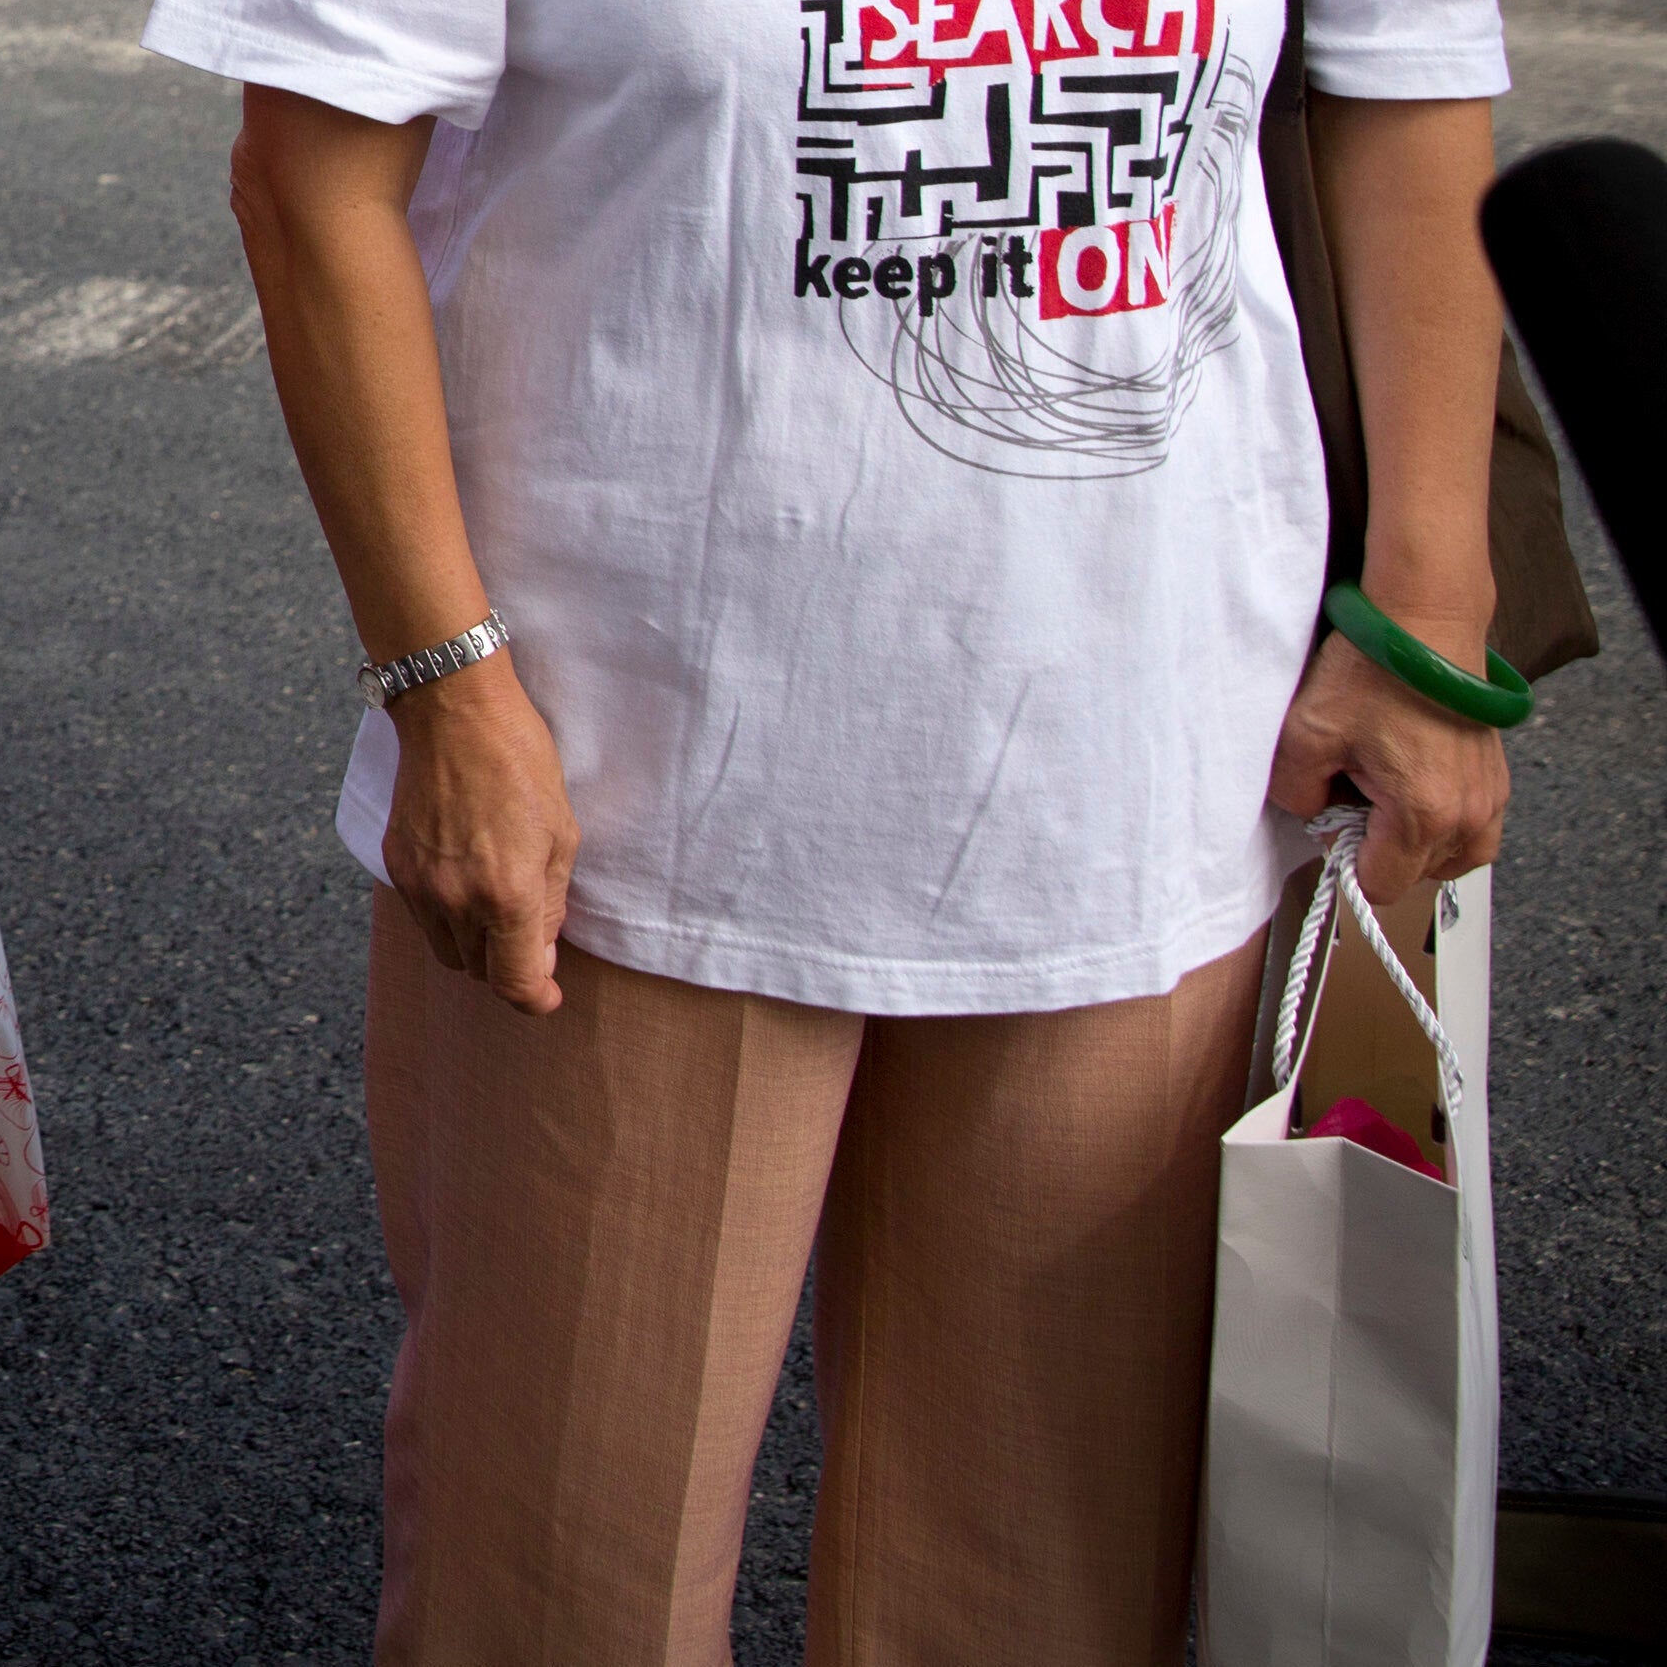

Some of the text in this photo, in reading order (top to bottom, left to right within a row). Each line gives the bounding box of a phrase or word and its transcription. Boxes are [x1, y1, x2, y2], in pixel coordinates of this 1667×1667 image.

[794, 222, 1172, 317] keep it ON
